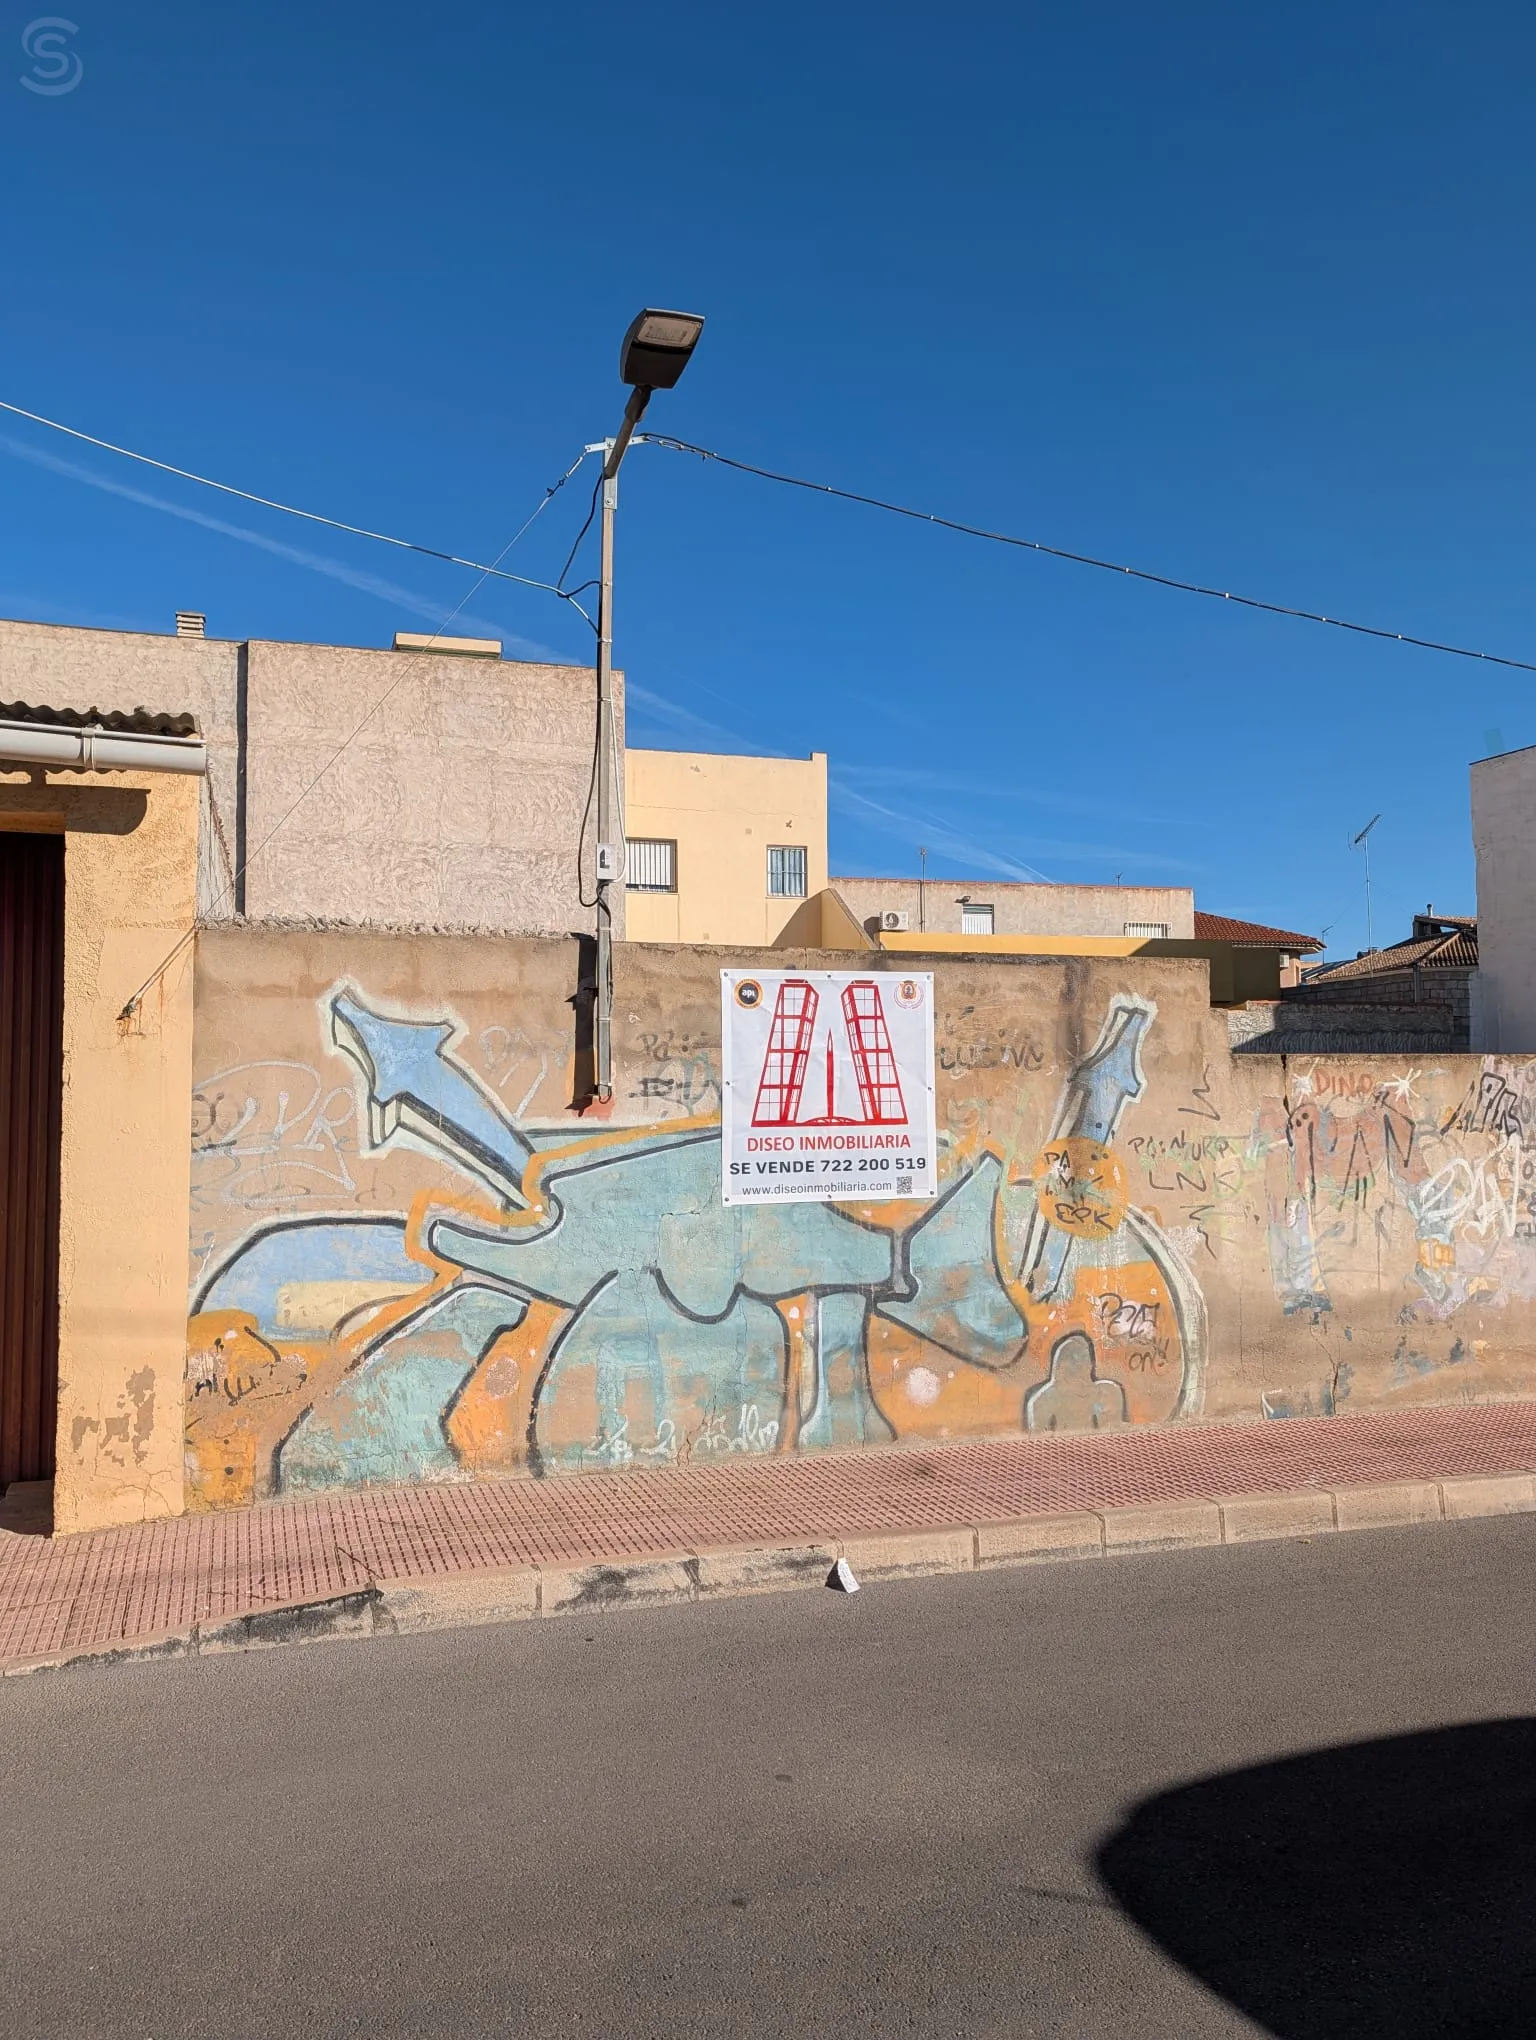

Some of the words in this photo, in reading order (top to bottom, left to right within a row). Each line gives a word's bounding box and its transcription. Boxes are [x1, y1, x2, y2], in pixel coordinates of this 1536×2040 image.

[1314, 1068, 1373, 1097] DINO
[747, 1136, 795, 1152] DISEO
[799, 1134, 912, 1151] INMOBILIARIA
[729, 1162, 751, 1175] SE
[756, 1160, 815, 1174] VENDE
[820, 1159, 853, 1173] 722
[858, 1158, 890, 1172] 200
[895, 1156, 926, 1170] 519
[742, 1180, 893, 1196] www.diseoinmobiliaria.com
